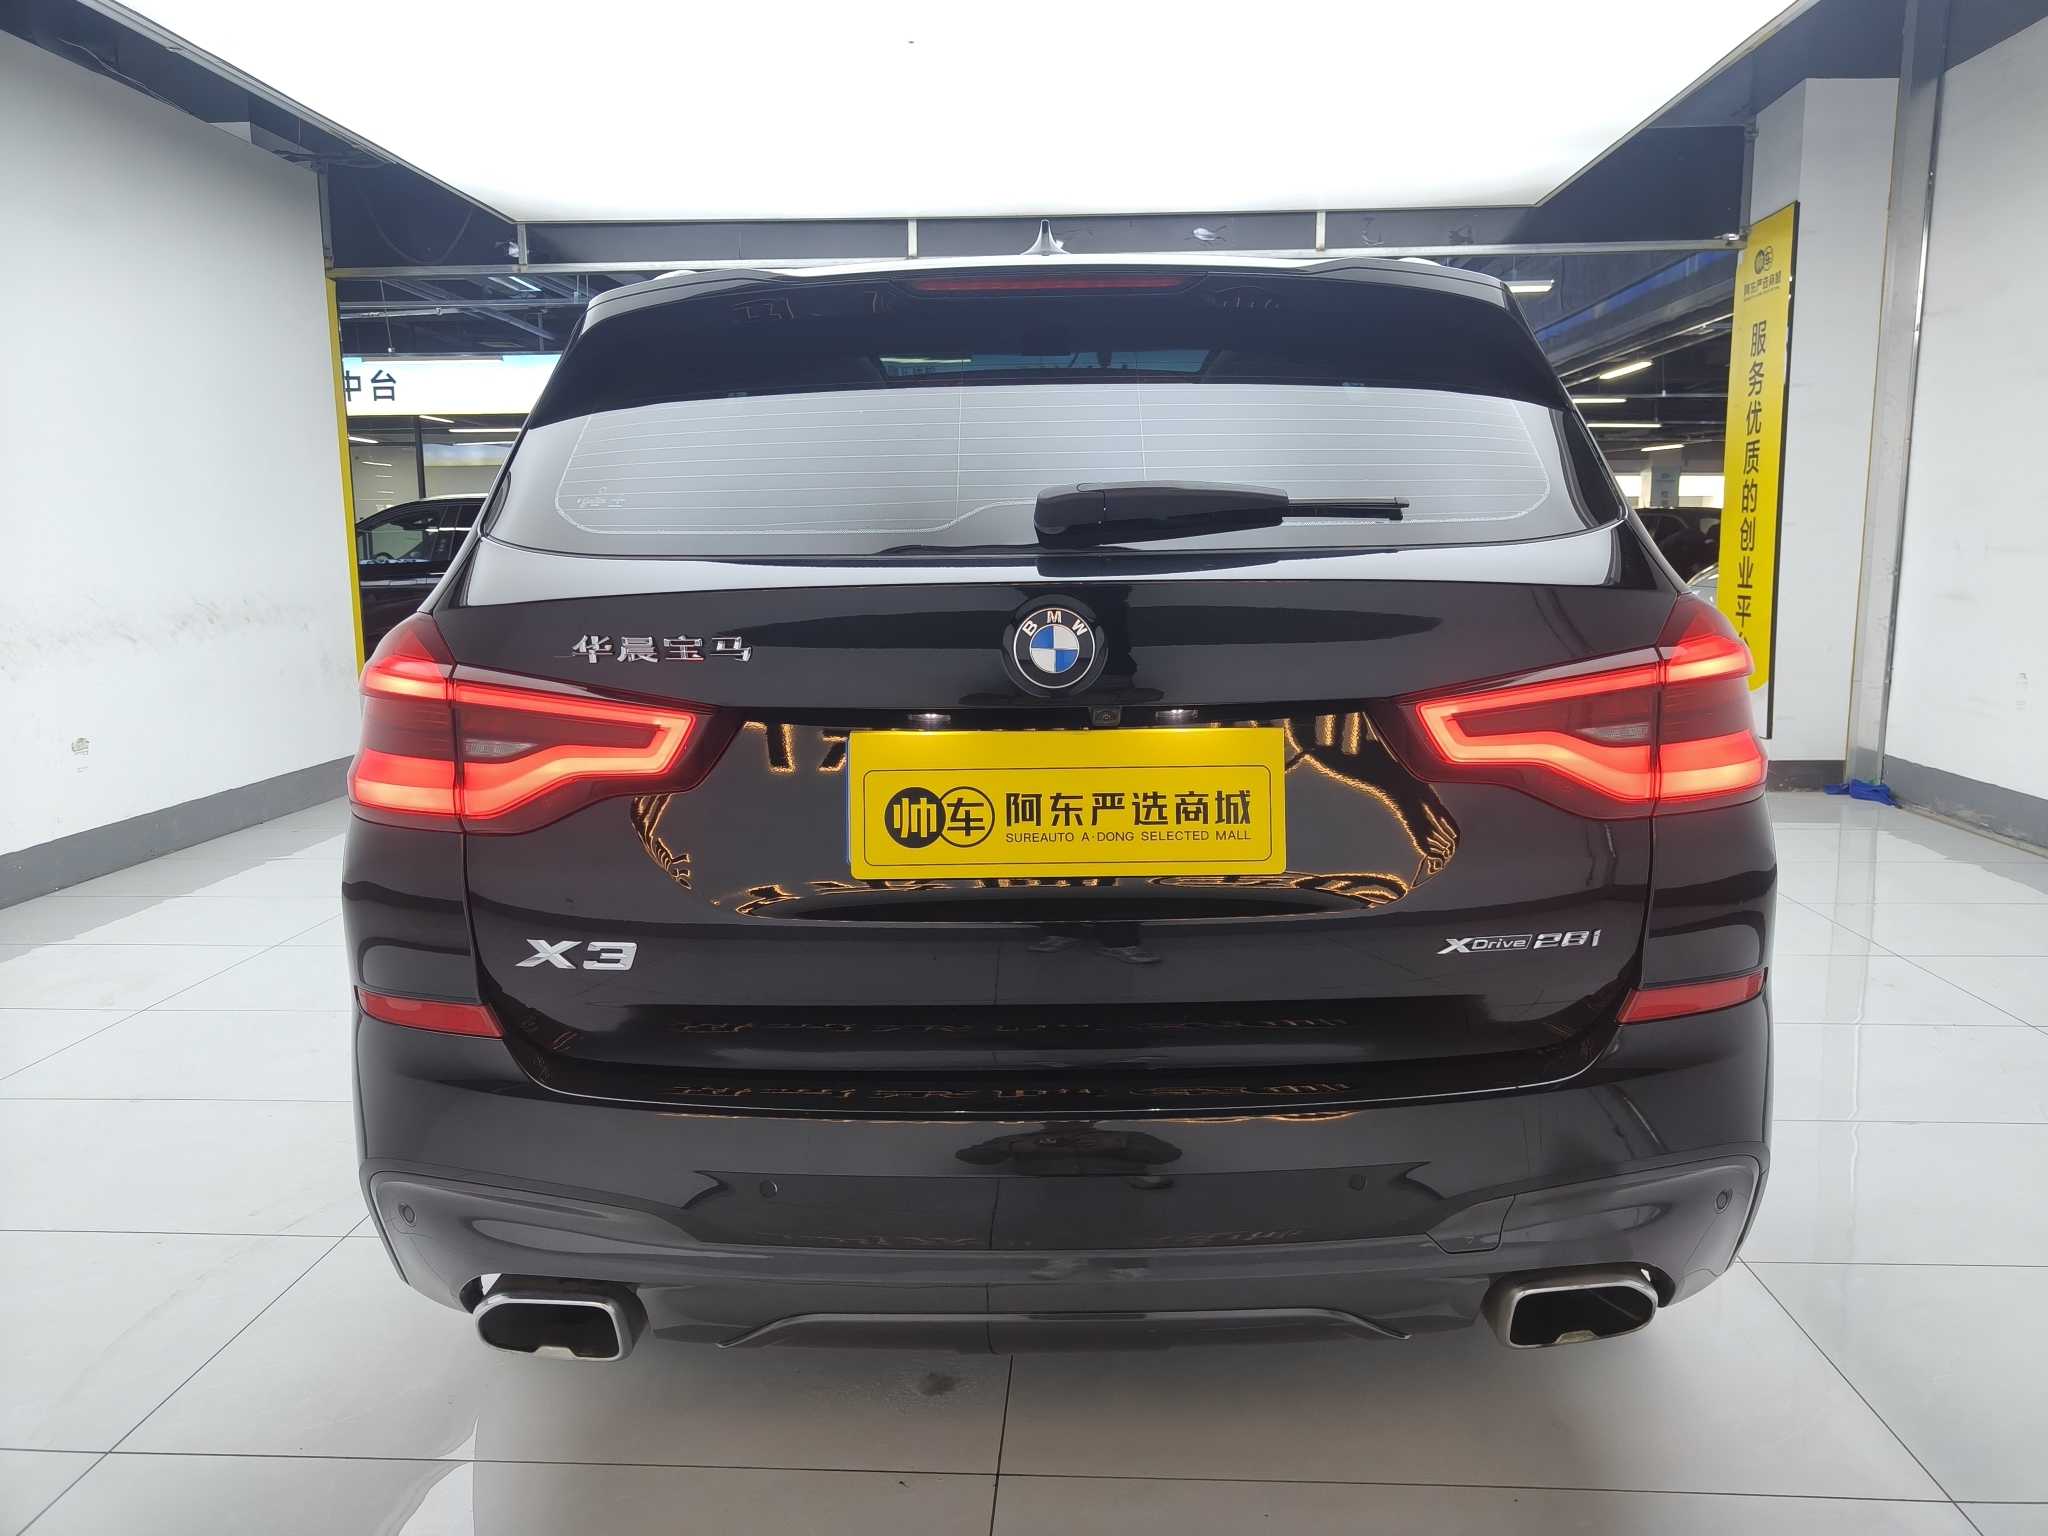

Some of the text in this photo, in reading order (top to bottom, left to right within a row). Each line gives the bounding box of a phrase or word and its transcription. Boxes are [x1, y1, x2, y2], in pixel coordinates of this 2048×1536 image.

[1736, 320, 1767, 648] 服务优质的创业平
[1022, 610, 1088, 637] BMW
[572, 635, 752, 664] 华晨宝马
[1006, 789, 1251, 827] 阿东严选商城
[1006, 832, 1075, 843] SUREAUTO
[1141, 830, 1209, 841] SELECTED
[1215, 830, 1252, 841] MALL
[1533, 929, 1601, 949] 28i
[514, 939, 638, 971] X3
